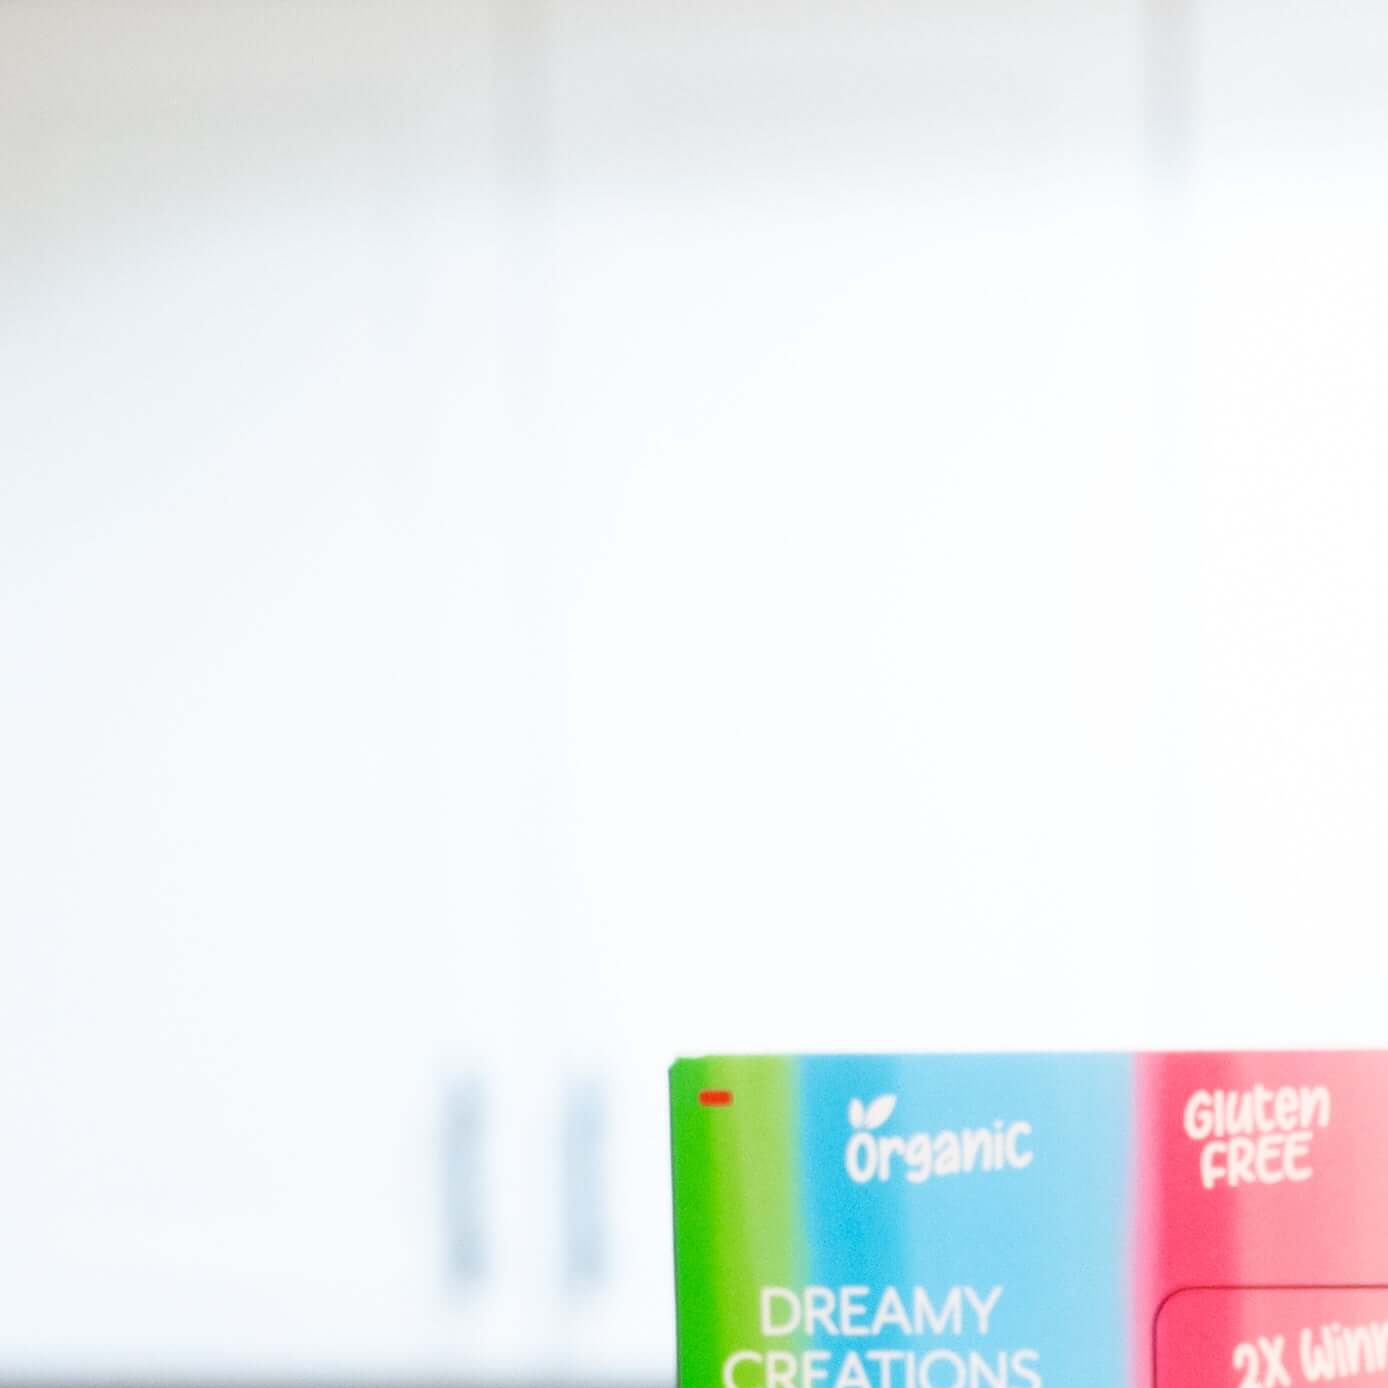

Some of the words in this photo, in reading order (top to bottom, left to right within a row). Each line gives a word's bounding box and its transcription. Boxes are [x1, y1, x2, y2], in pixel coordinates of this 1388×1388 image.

[1184, 1083, 1330, 1140] Gluten
[845, 1119, 1034, 1184] Organic
[1202, 1130, 1312, 1189] FREE
[760, 1285, 1003, 1337] DREAMY
